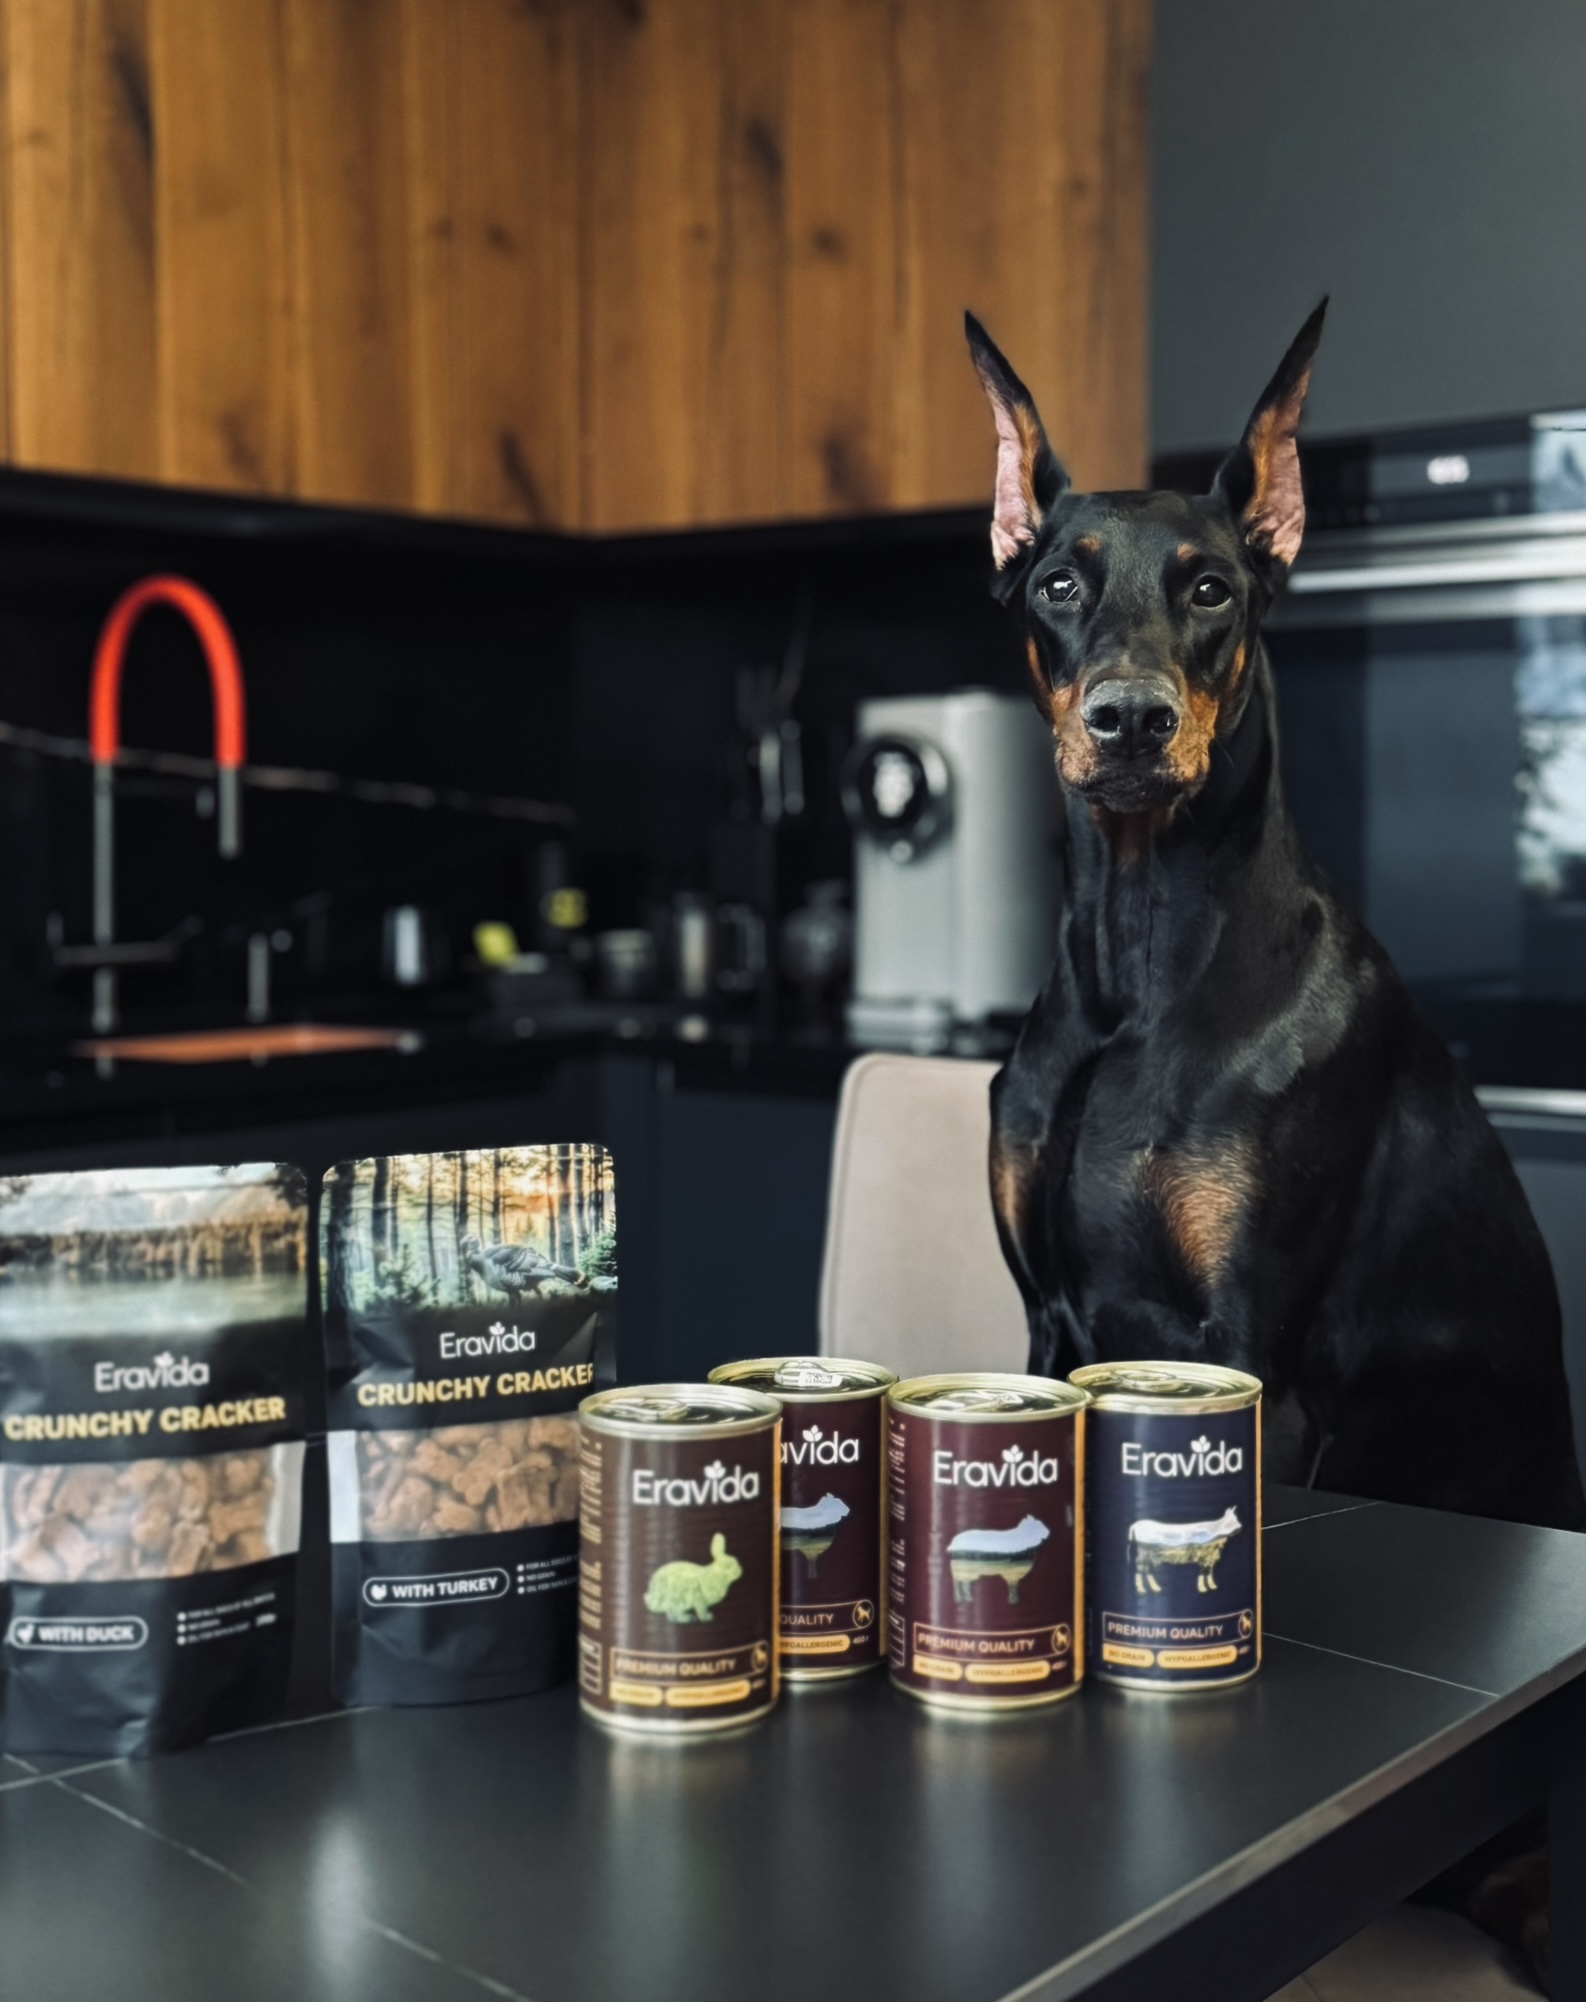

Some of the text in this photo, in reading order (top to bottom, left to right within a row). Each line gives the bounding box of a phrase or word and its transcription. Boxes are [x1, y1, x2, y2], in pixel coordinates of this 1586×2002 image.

[440, 1321, 536, 1359] Eravida
[95, 1351, 210, 1392] Eravida
[358, 1375, 491, 1407] CRUNCHY
[4, 1396, 287, 1440] CRUNCHY CRACKER
[933, 1444, 1059, 1488] Eravida
[1121, 1434, 1243, 1477] Eravida
[632, 1459, 760, 1507] Eravida
[392, 1576, 498, 1599] WITH TURKEY
[780, 1613, 834, 1626] QUALITY
[1108, 1622, 1224, 1640] PREMIUM QUALITY
[38, 1625, 135, 1642] WITH DUCK
[918, 1632, 1035, 1654] PREMIUM QUALITY
[616, 1656, 737, 1677] PREMIUM QUALITY
[1108, 1649, 1120, 1658] NO
[1121, 1652, 1146, 1662] GRAIN
[1165, 1650, 1233, 1664] HYPOALLERGENIC
